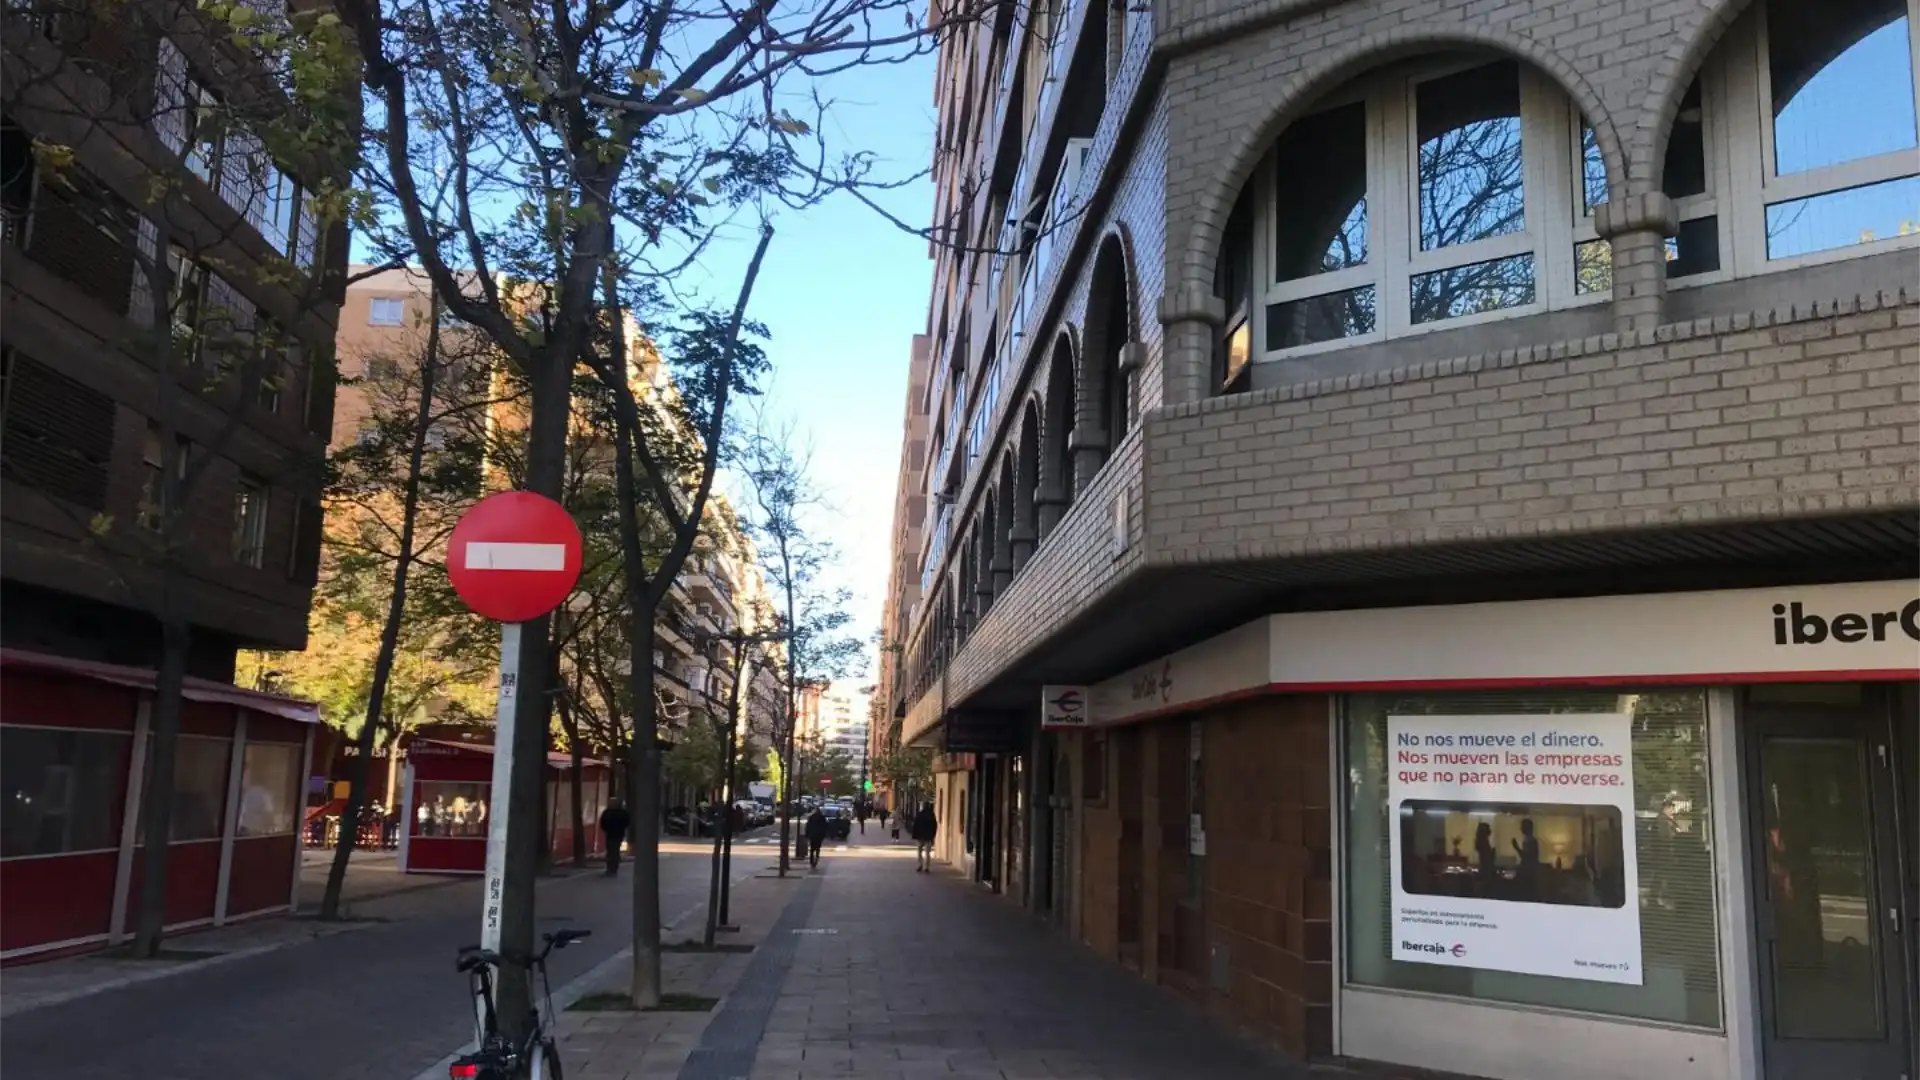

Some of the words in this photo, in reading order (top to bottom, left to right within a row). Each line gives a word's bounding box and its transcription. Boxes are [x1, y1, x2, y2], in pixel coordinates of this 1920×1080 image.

[1398, 733, 1419, 746] No
[1425, 735, 1453, 746] nos
[1459, 735, 1516, 746] mueve
[1521, 732, 1535, 746] el
[1542, 731, 1604, 746] dinero.
[1398, 750, 1428, 764] Nos
[1434, 753, 1499, 765] mueven
[1505, 751, 1529, 765] las
[1534, 754, 1623, 768] empresas
[1398, 771, 1428, 784] que
[1433, 771, 1453, 782] no
[1459, 771, 1508, 785] paran
[1514, 770, 1535, 784] de
[1542, 773, 1625, 786] moverse.
[1402, 941, 1445, 955] Ibercaja
